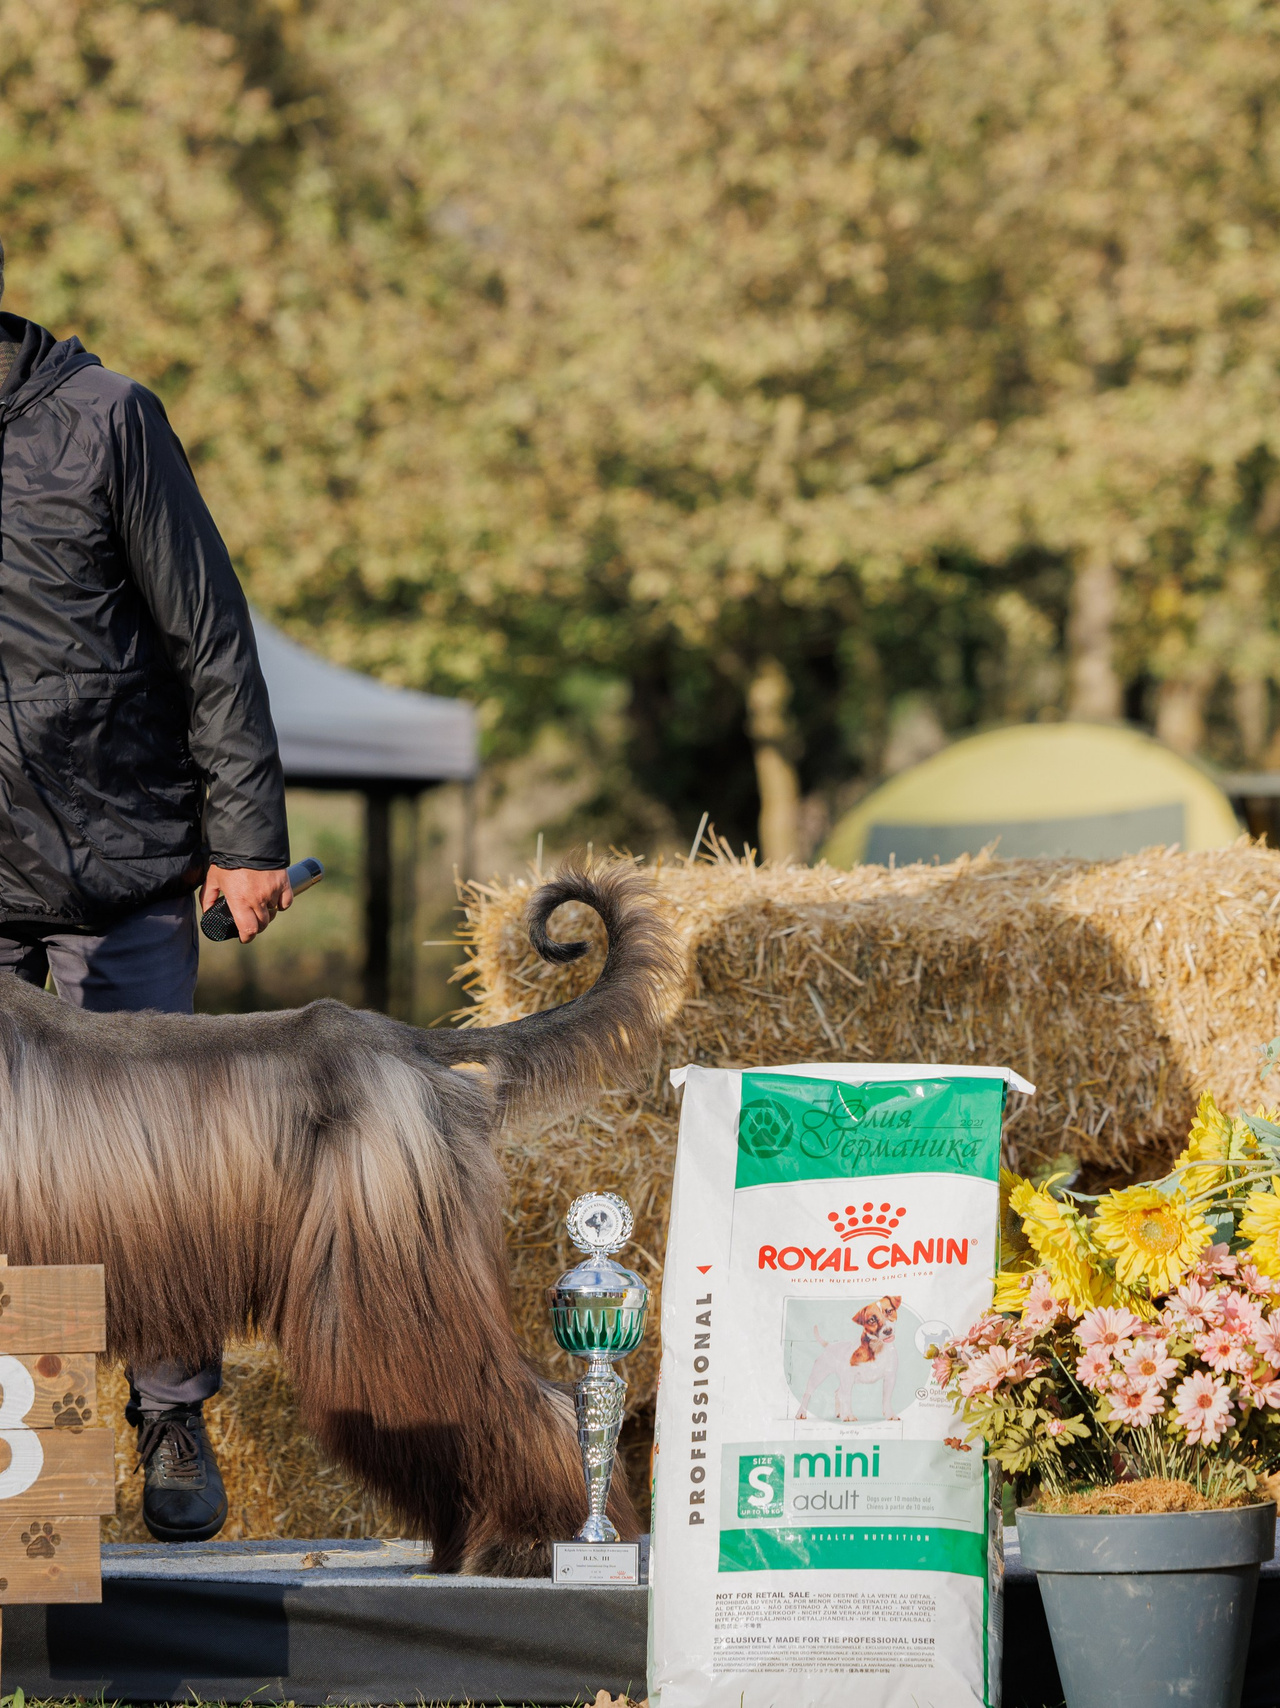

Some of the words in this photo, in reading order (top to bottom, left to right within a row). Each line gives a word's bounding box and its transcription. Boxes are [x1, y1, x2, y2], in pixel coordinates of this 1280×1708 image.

[758, 1244, 859, 1272] ROYAL
[867, 1238, 968, 1269] CANIN
[689, 1292, 713, 1526] PROFESSIONAL
[793, 1445, 880, 1479] mini
[747, 1466, 774, 1507] S
[792, 1490, 860, 1511] adult
[864, 1534, 930, 1542] NUTRITION
